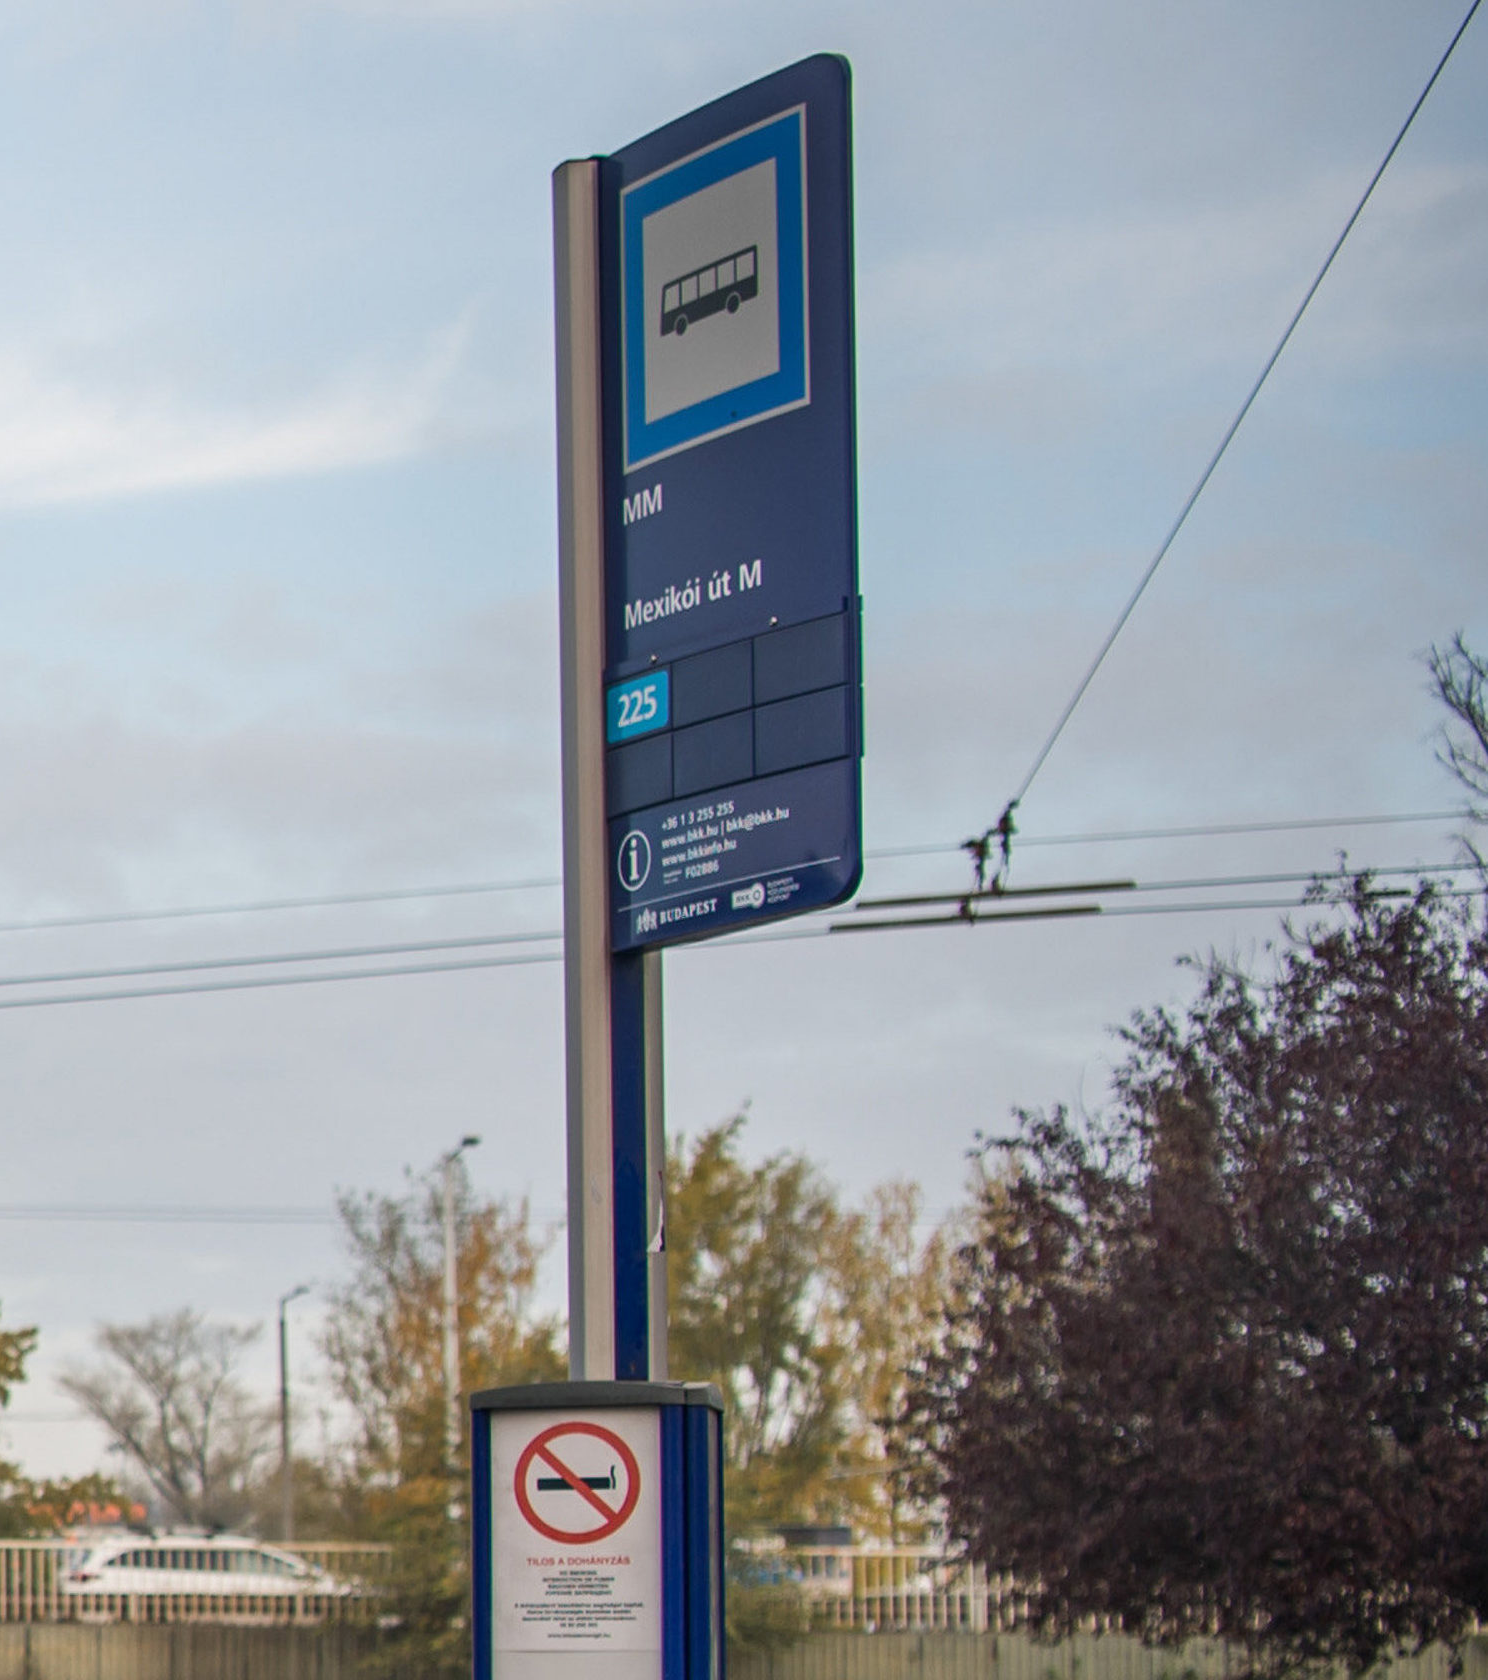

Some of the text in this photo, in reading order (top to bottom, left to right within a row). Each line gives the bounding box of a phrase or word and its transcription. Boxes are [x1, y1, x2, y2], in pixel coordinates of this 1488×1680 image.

[623, 483, 663, 525] MM
[624, 559, 762, 631] Mexikói út M
[618, 684, 657, 728] 225
[661, 814, 678, 831] +36
[688, 808, 695, 825] 3
[697, 804, 714, 822] 255
[716, 800, 735, 818] 255
[661, 807, 790, 849] www.bkk.hu bkk@bkk.hu
[661, 837, 737, 867] www.bkkinfo.hu
[660, 898, 718, 924] BUDAPEST
[526, 1555, 631, 1566] TILOS A DOHÁNYZÁS
